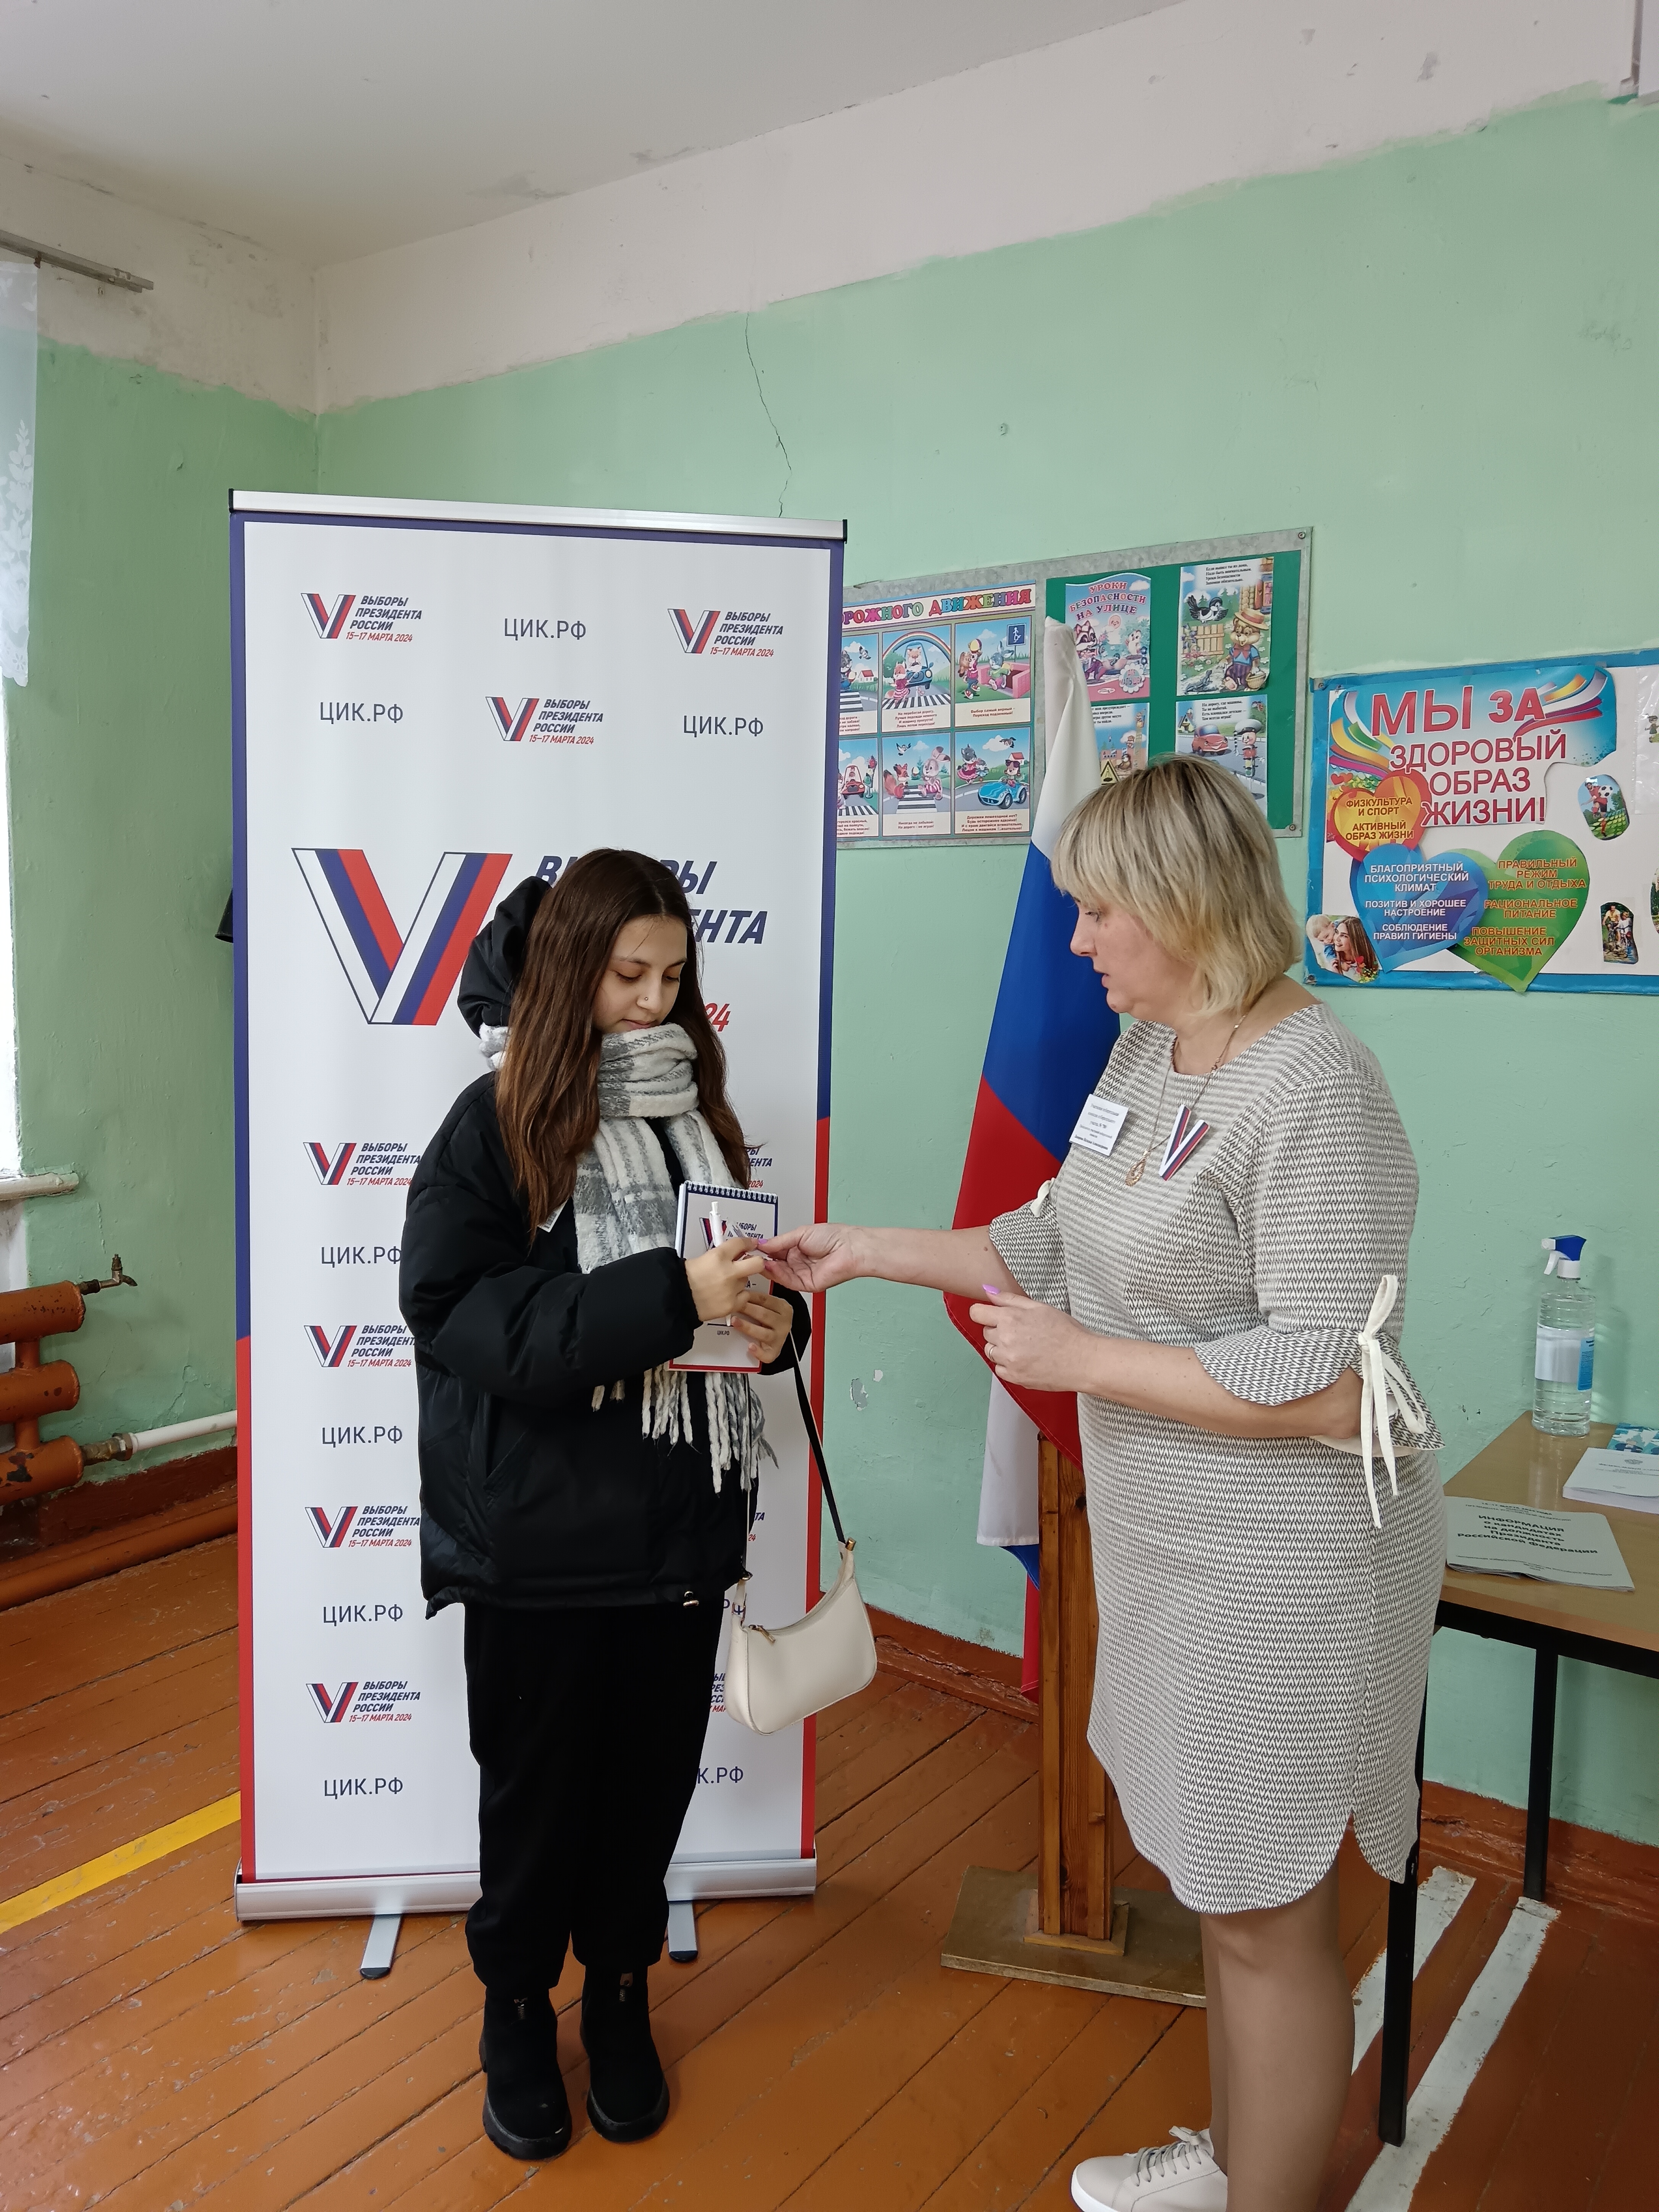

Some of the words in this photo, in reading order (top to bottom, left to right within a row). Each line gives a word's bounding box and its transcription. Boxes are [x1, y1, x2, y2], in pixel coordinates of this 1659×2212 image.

[1089, 582, 1127, 594] УРОКИ
[361, 595, 409, 606] ВЫБОРЫ
[1069, 593, 1146, 613] БЕЗОПАСНОСТИ
[842, 602, 924, 625] РОЖНОГО
[929, 589, 1032, 616] ДВИЖЕНИЯ
[1076, 609, 1093, 621] НА
[1096, 604, 1137, 615] УЛИЦЕ
[355, 608, 422, 619] ПРЕЗИДЕНТА
[725, 611, 771, 622] ВЫБОРЫ
[350, 620, 393, 631] РОССИИ
[504, 618, 586, 641] ЦИК.РФ
[720, 623, 783, 635] ПРЕЗИДЕНТА
[367, 633, 393, 641] МАРТА
[394, 634, 412, 642] 2024
[714, 635, 756, 645] РОССИИ
[731, 648, 755, 656] МАРТА
[543, 699, 590, 709] ВЫБОРЫ
[320, 702, 403, 724] ЦИК.РФ
[1371, 686, 1473, 736] МЫ
[1488, 688, 1546, 723] ЗА
[538, 711, 603, 723] ПРЕЗИДЕНТА
[533, 723, 575, 733] РОССИИ
[683, 715, 763, 738] ЦИК.РФ
[550, 736, 575, 744] МАРТА
[576, 736, 594, 744] 2024
[1389, 729, 1566, 773] ЗДОРОВЫЙ
[1429, 767, 1531, 796] ОБРАЗ
[1346, 797, 1413, 807] ФИЗКУЛЬТУРА
[1367, 807, 1399, 816] СПОРТ
[1421, 797, 1545, 826] ЖИЗНИ!
[1352, 820, 1406, 831] АКТИВНЫЙ
[1345, 832, 1376, 840] ОБРАЗ
[1379, 830, 1413, 839] ЖИЗНИ
[1370, 861, 1463, 873] БЛАГОПРИЯТНЫЙ
[1498, 857, 1577, 869] ПРАВИЛЬНЫЙ
[1365, 871, 1469, 883] ПСИХОЛОГИЧЕСКИЙ
[1517, 870, 1557, 878] РЕЖИМ
[1395, 883, 1436, 892] КЛИМАТ
[1488, 880, 1523, 891] ТРУДА
[1526, 880, 1534, 889] И
[1537, 879, 1586, 889] ОТДЫХА
[1419, 899, 1466, 907] ХОРОШЕЕ
[1484, 899, 1578, 910] РАЦИОНАЛЬНОЕ
[1504, 909, 1556, 918] ПИТАНИЕ
[1382, 923, 1448, 932] СОБЛЮДЕНИЕ
[1472, 927, 1546, 936] ПОВЫШЕНИЕ
[1413, 932, 1457, 940] ГИГИЕНЫ
[1464, 937, 1528, 946] ЗАЩИТНЫХ
[1531, 937, 1554, 946] СИЛ
[1475, 947, 1543, 956] ОРГАНИЗМА
[361, 1143, 408, 1152] ВЫБОРЫ
[356, 1155, 420, 1165] ПРЕЗИДЕНТА
[351, 1166, 393, 1175] РОССИИ
[321, 1246, 401, 1268] ЦИК.РФ
[362, 1325, 407, 1334] ВЫБОРЫ
[356, 1337, 416, 1346] ПРЕЗИДЕНТ
[351, 1348, 393, 1357] РОССИИ
[322, 1426, 403, 1448] ЦИК.РФ
[362, 1506, 408, 1514] ВЫБОРЫ
[357, 1517, 420, 1526] ПРЕЗИДЕНТА
[1478, 1515, 1564, 1532] ИНФОРМАЦИЯ
[352, 1528, 393, 1537] РОССИИ
[1494, 1522, 1561, 1536] кандидатах
[1501, 1528, 1565, 1541] должность
[1457, 1533, 1526, 1544] Российской
[1529, 1541, 1598, 1554] Федерации
[1490, 1530, 1560, 1546] Президента
[323, 1604, 403, 1626] ЦИК.РФ
[363, 1681, 407, 1690] ВЫБОРЫ
[357, 1692, 420, 1701] ПРЕЗИДЕНТА
[352, 1703, 394, 1712] РОССИИ
[369, 1714, 394, 1722] МАРТА
[394, 1713, 412, 1721] 2024
[698, 1766, 744, 1784] К.РФ
[325, 1777, 403, 1800] ЦИК.РФ
